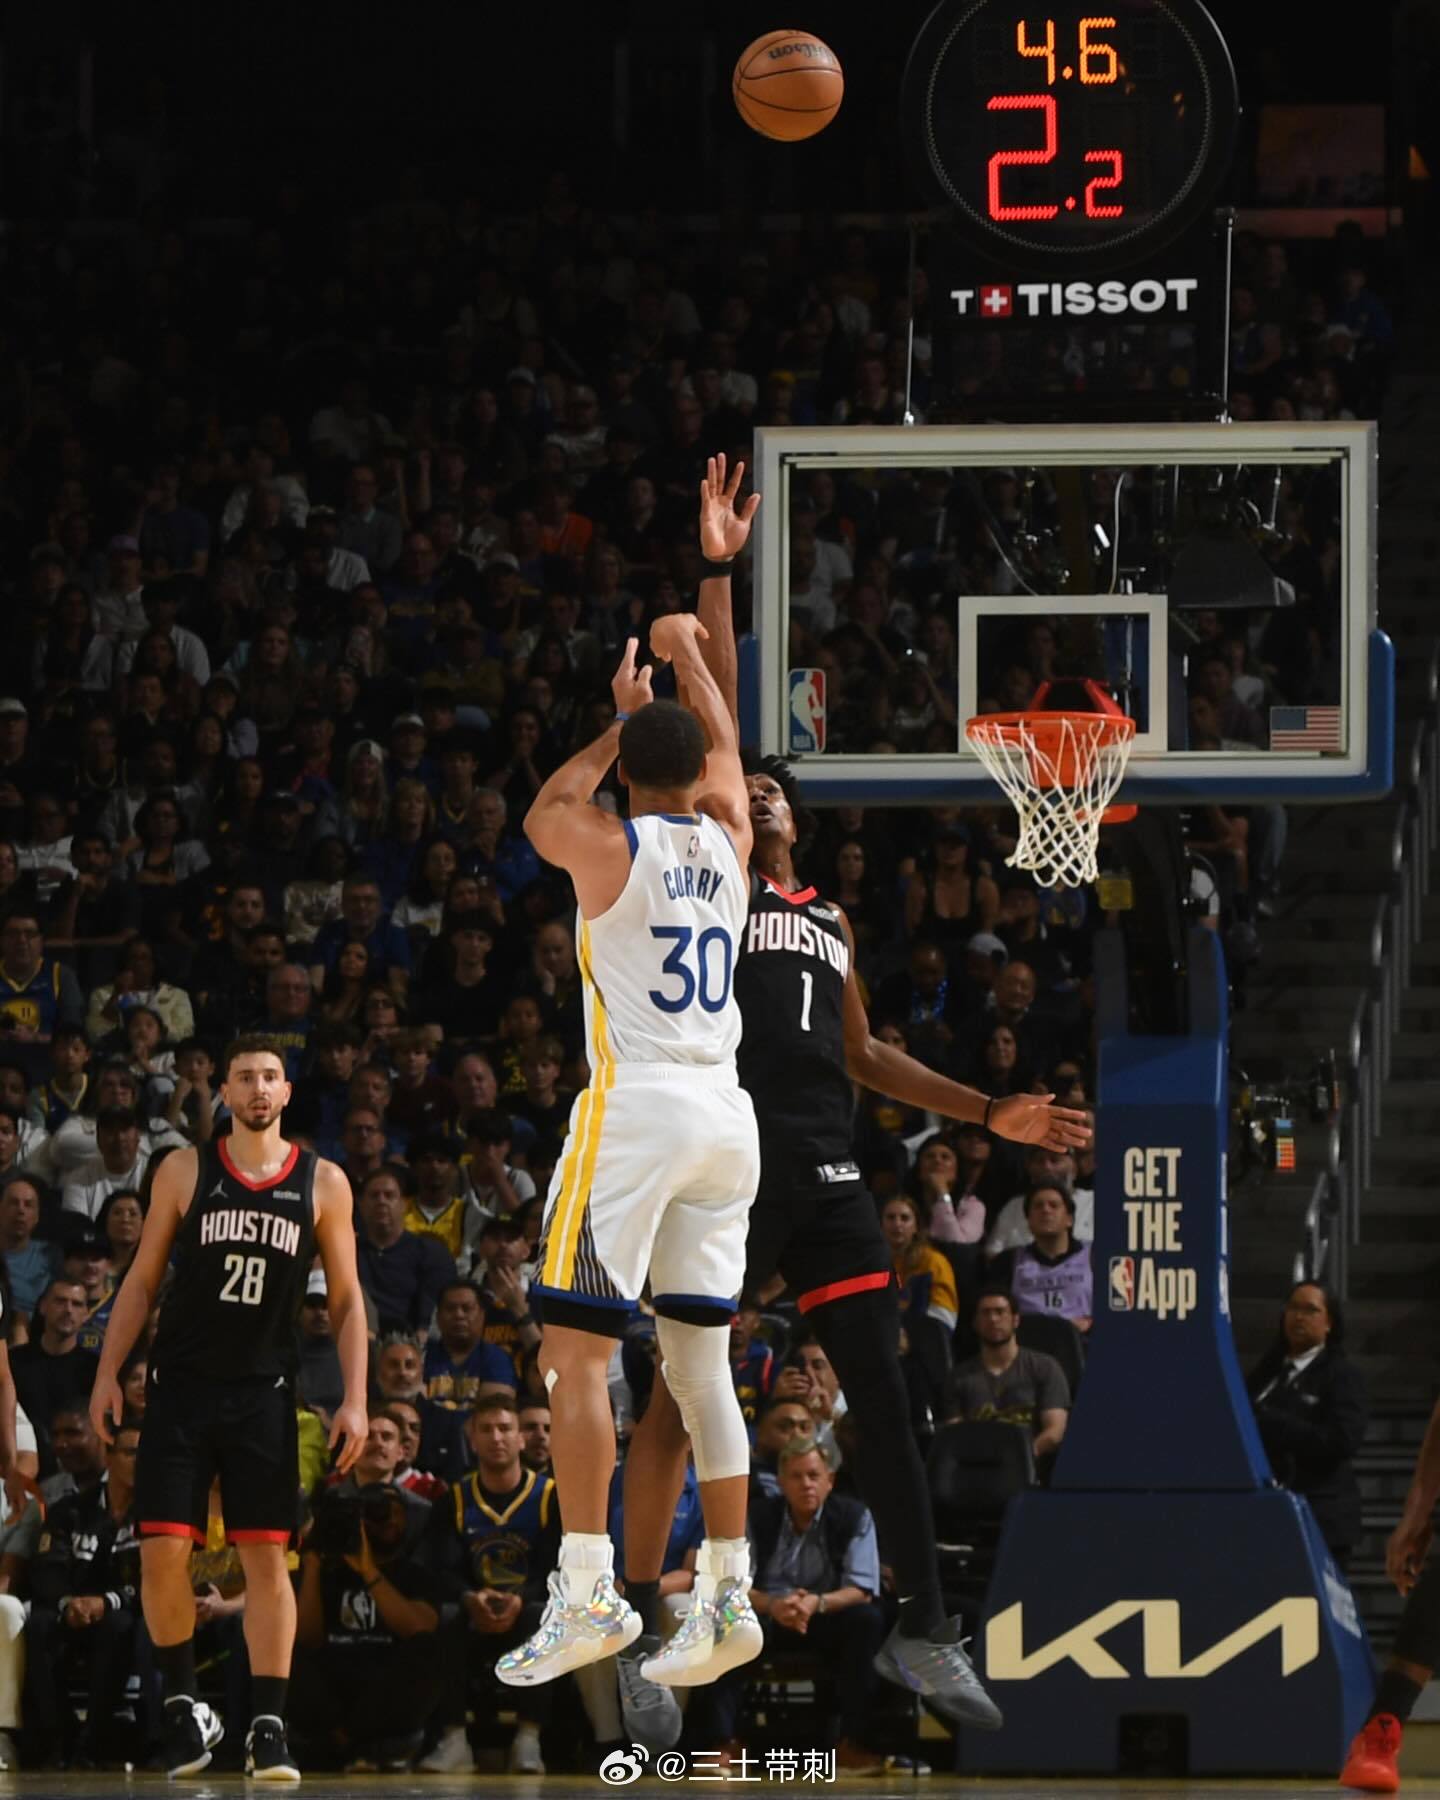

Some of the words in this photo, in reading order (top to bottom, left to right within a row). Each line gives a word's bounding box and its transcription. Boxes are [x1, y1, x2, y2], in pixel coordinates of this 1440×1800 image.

[1016, 17, 1118, 85] 4.6
[985, 94, 1124, 221] 2.2
[951, 290, 974, 314] T
[1017, 279, 1198, 316] TISSOT
[663, 867, 725, 904] CURRY
[648, 926, 733, 1013] 30
[746, 911, 849, 985] HOUSTON
[800, 970, 813, 1032] 1
[1123, 1146, 1183, 1198] GET
[200, 1209, 302, 1258] HOUSTON
[1122, 1201, 1184, 1252] THE
[219, 1253, 267, 1305] 28
[1136, 1256, 1198, 1321] App
[985, 1596, 1320, 1681] KIA
